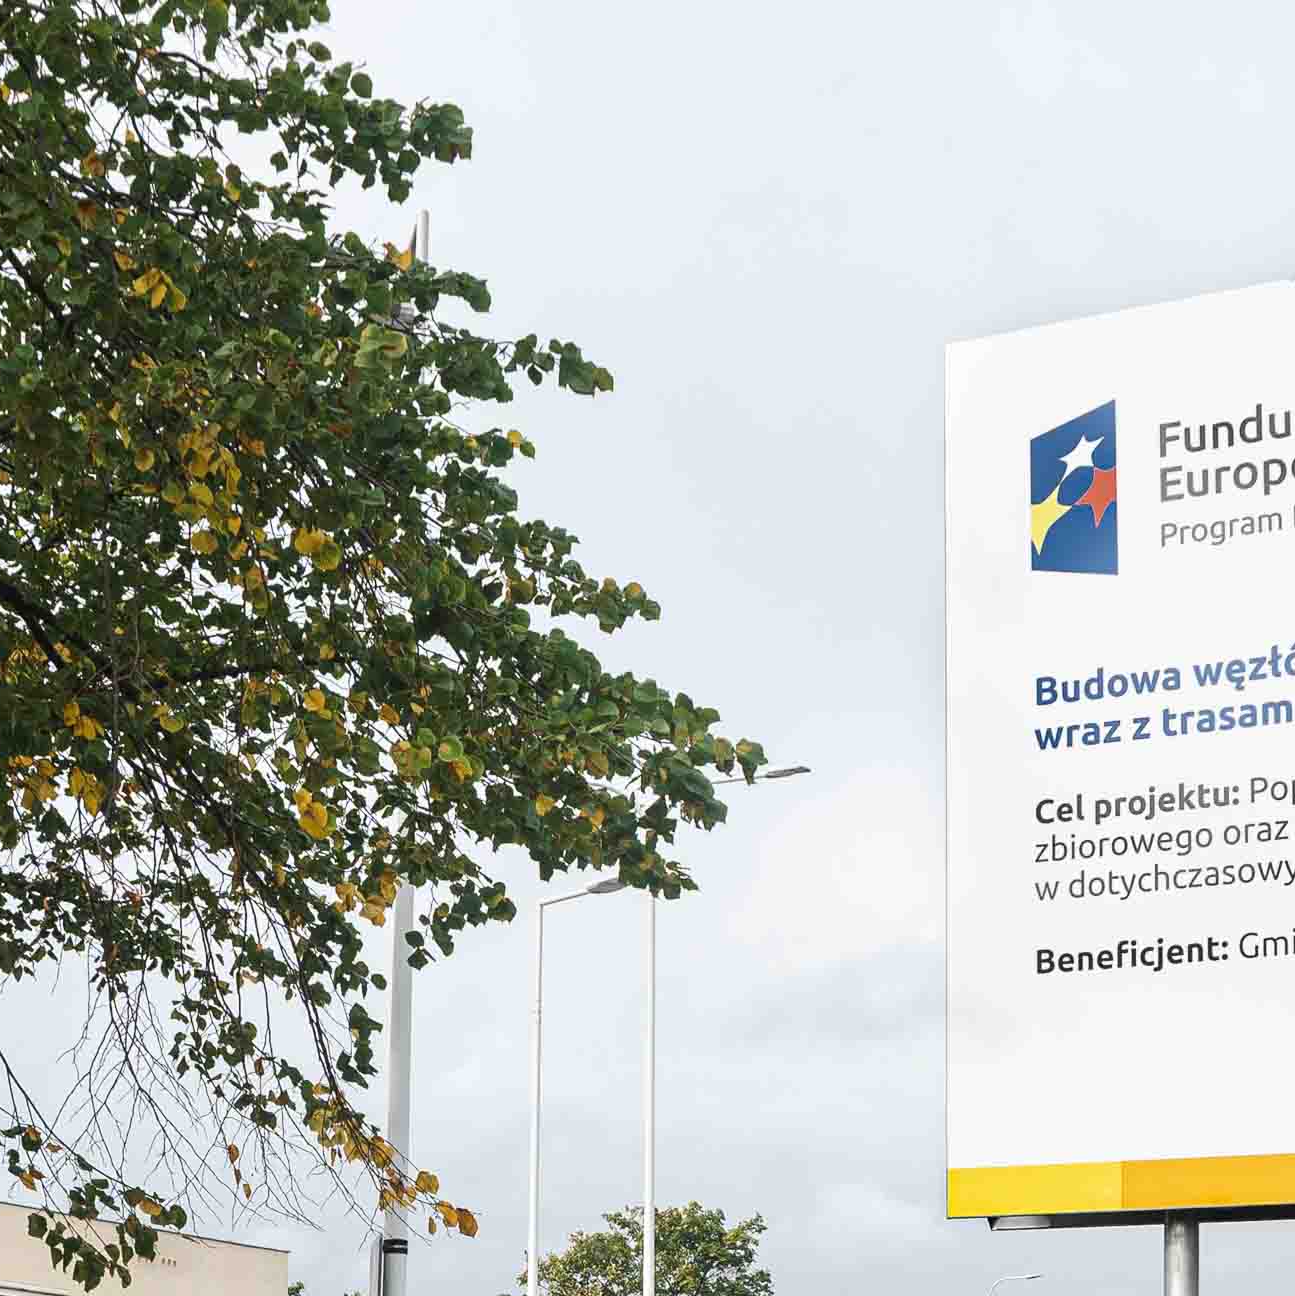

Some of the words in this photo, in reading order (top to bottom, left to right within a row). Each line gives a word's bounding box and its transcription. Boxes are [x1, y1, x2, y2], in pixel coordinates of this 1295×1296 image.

[1162, 513, 1282, 547] Program
[1036, 668, 1180, 706] Budowa
[1035, 720, 1121, 750] wraz
[1133, 717, 1150, 740] z
[1036, 794, 1084, 824] Cel
[1095, 783, 1239, 825] projektu:
[1035, 828, 1212, 863] zbiorowego
[1224, 821, 1288, 845] oraz
[1035, 881, 1059, 900] w
[1037, 937, 1228, 974] Beneficjent:
